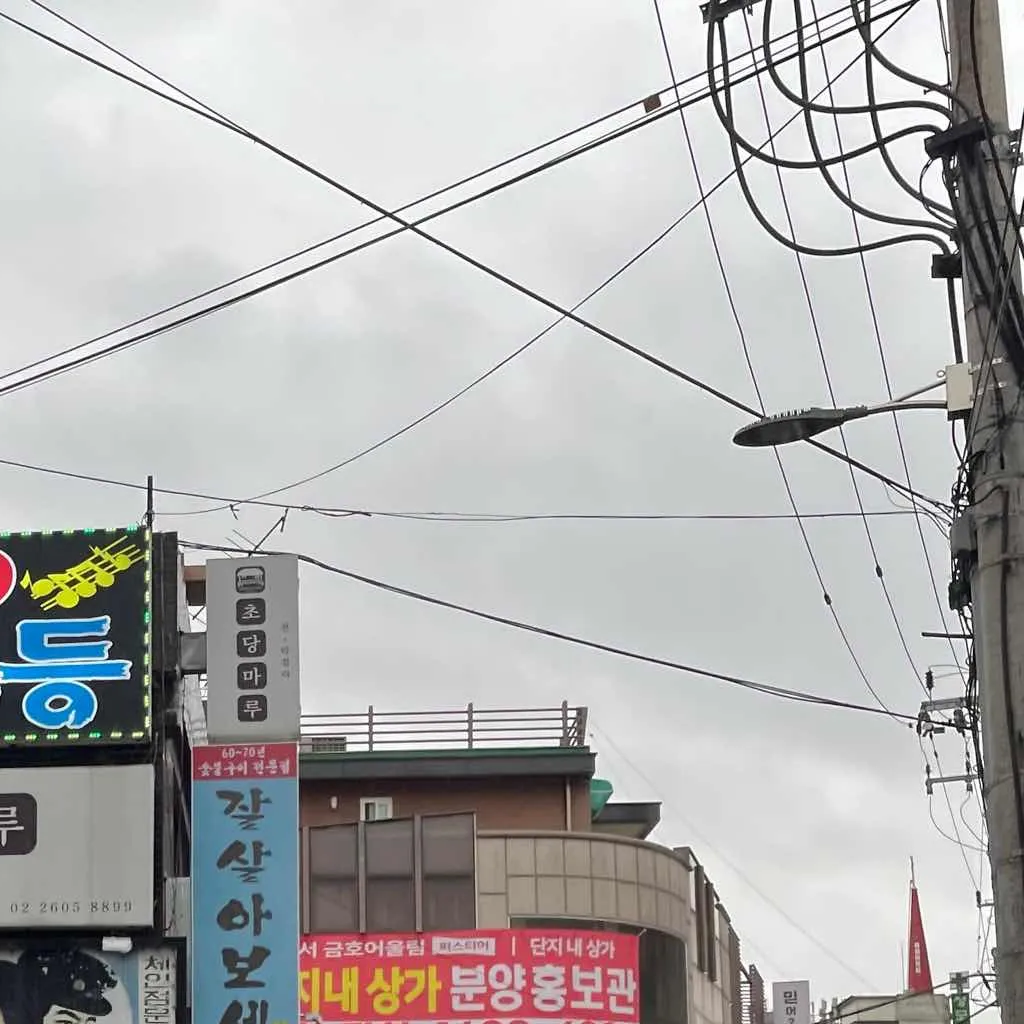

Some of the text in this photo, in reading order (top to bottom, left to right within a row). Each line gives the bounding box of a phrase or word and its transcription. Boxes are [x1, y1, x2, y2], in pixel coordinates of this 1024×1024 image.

[10, 901, 31, 914] 02
[324, 937, 425, 958] 금호어울림
[586, 939, 616, 959] 상가
[365, 965, 442, 1015] 상가
